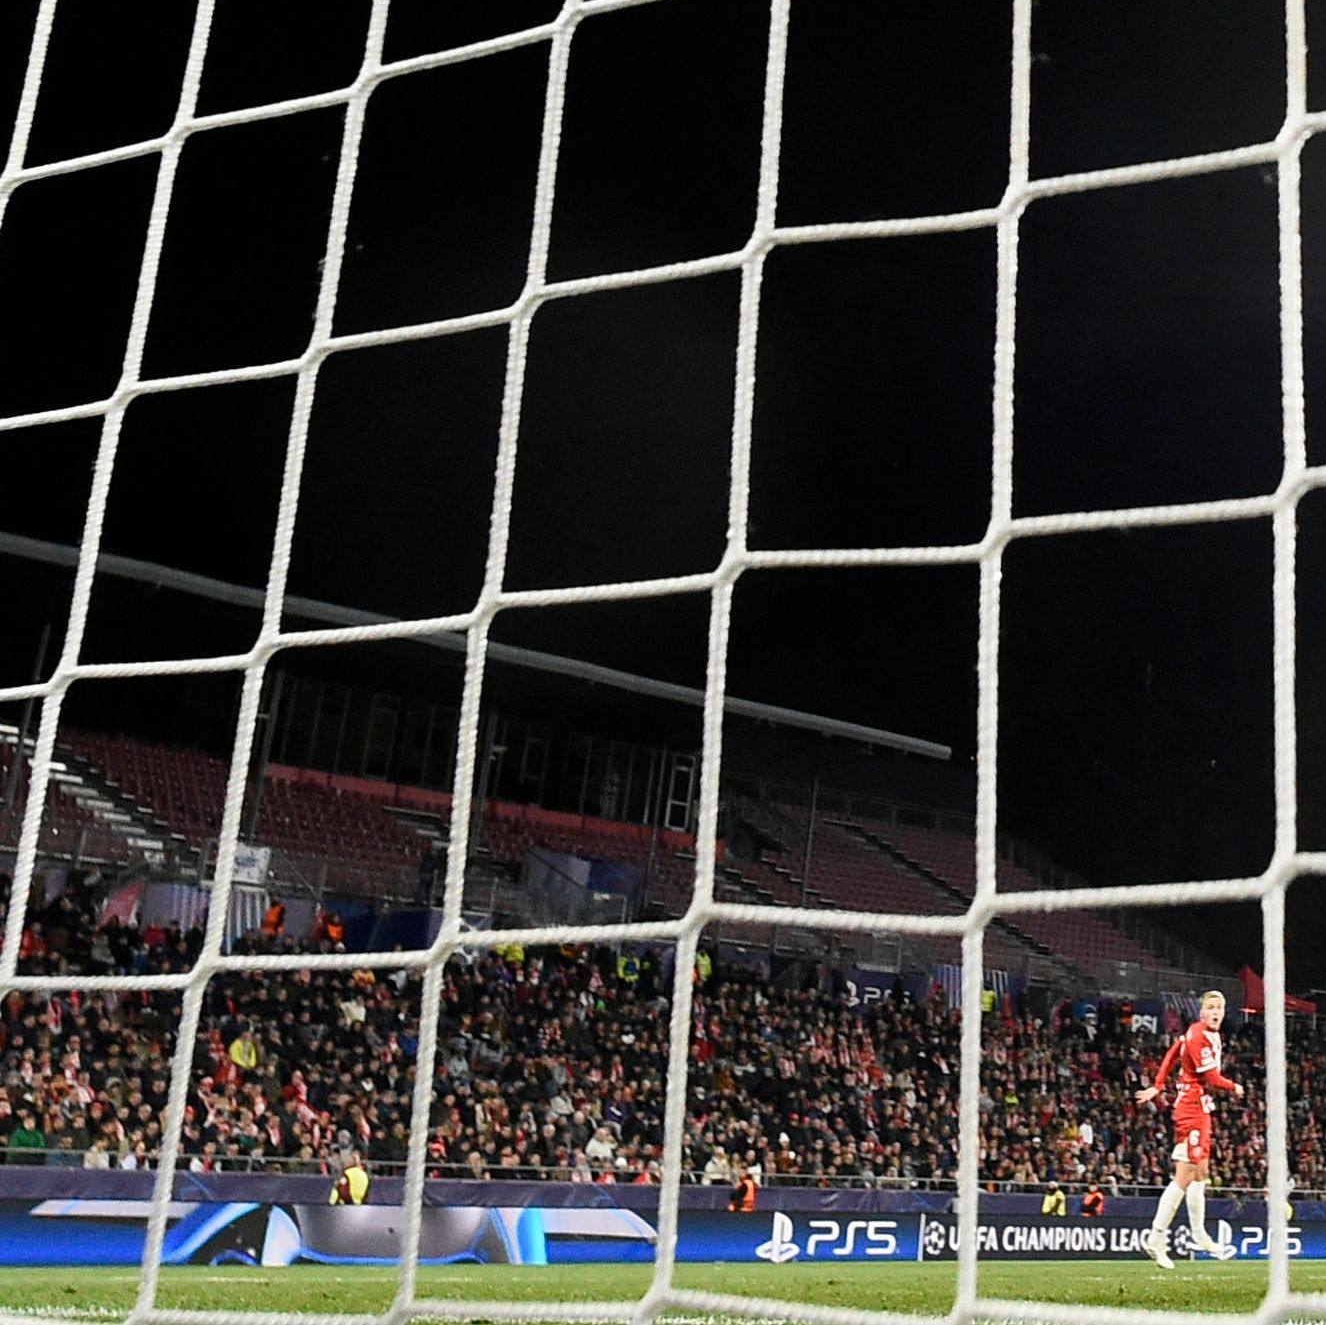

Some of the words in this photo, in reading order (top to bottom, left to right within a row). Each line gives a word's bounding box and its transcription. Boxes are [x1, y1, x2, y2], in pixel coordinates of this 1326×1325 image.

[806, 1220, 898, 1256] PS5
[948, 1225, 999, 1252] UFA
[1002, 1225, 1106, 1253] CHAMPIONS
